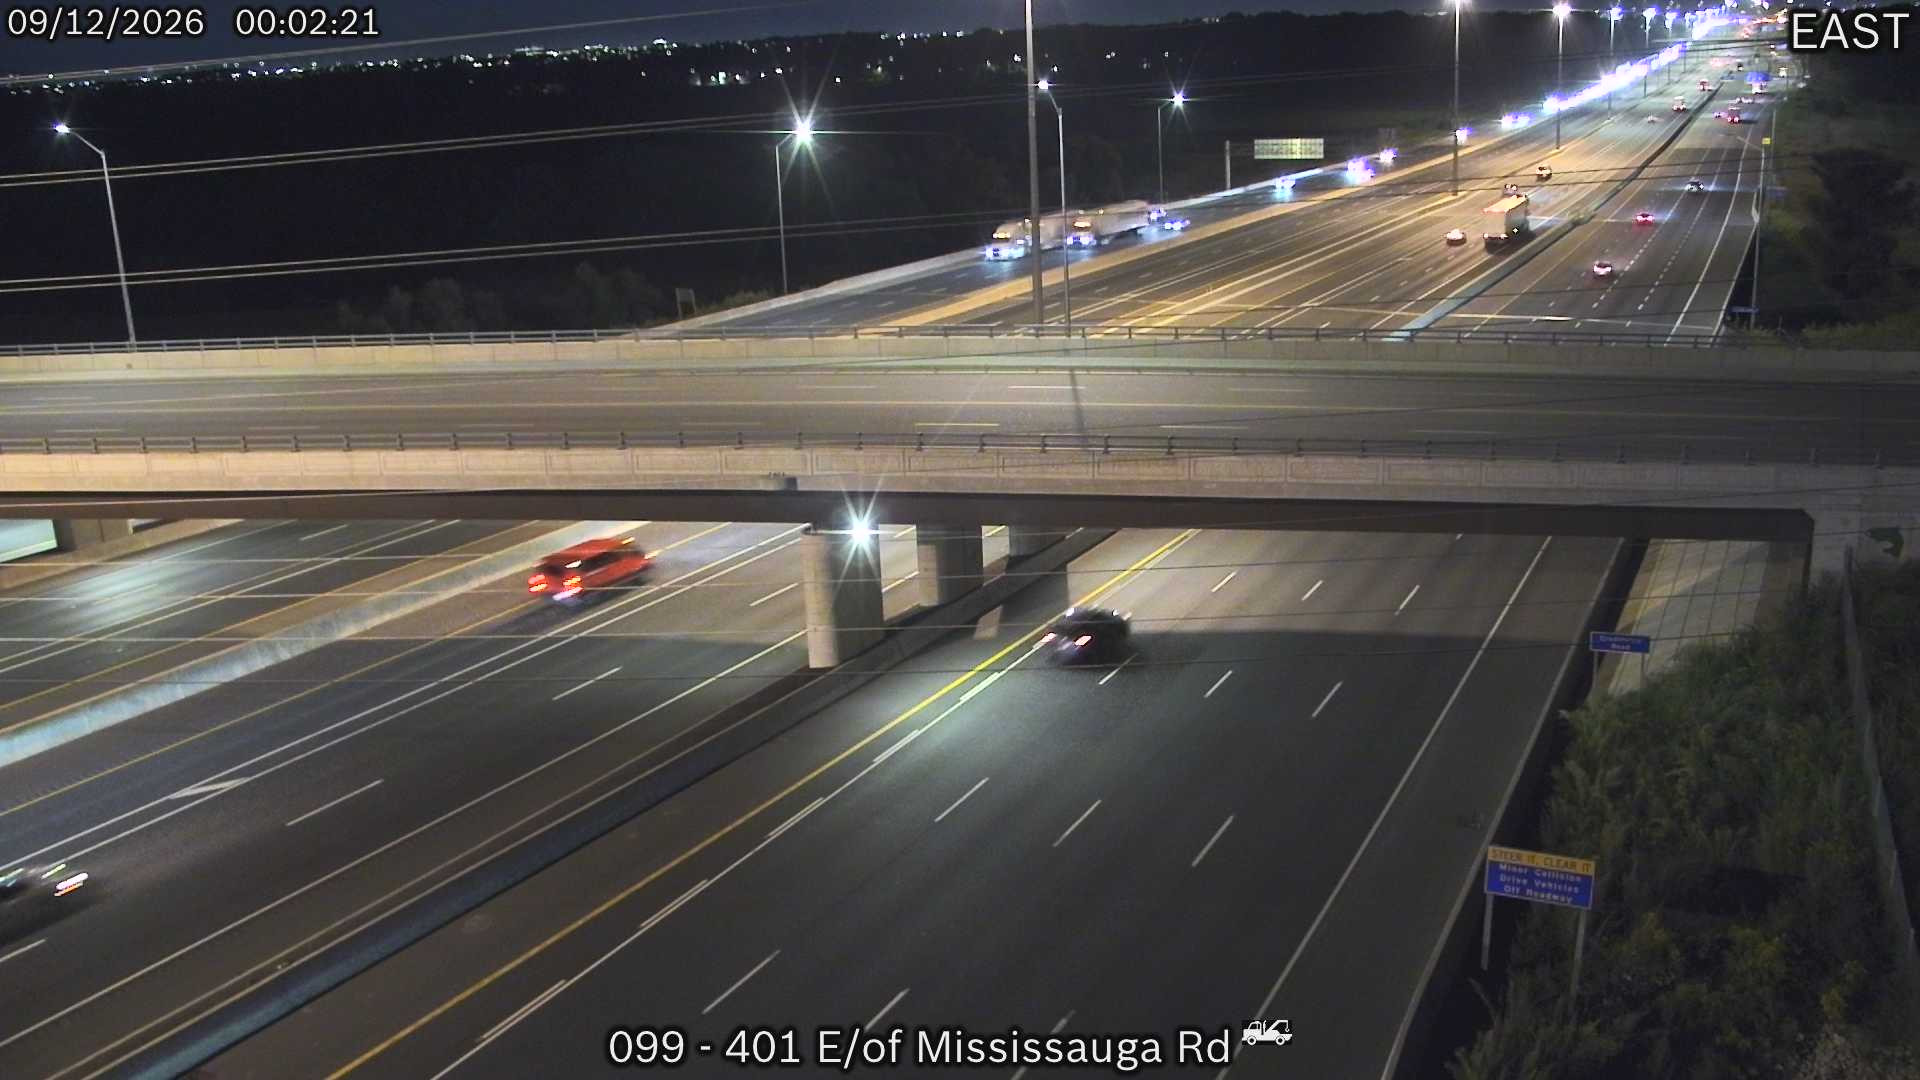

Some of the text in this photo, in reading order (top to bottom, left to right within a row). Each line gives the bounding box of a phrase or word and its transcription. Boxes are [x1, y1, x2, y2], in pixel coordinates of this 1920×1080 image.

[1499, 863, 1582, 882] Minor Collision
[1499, 874, 1579, 893] Drive Vehicles
[1504, 885, 1574, 904] Off Roadway
